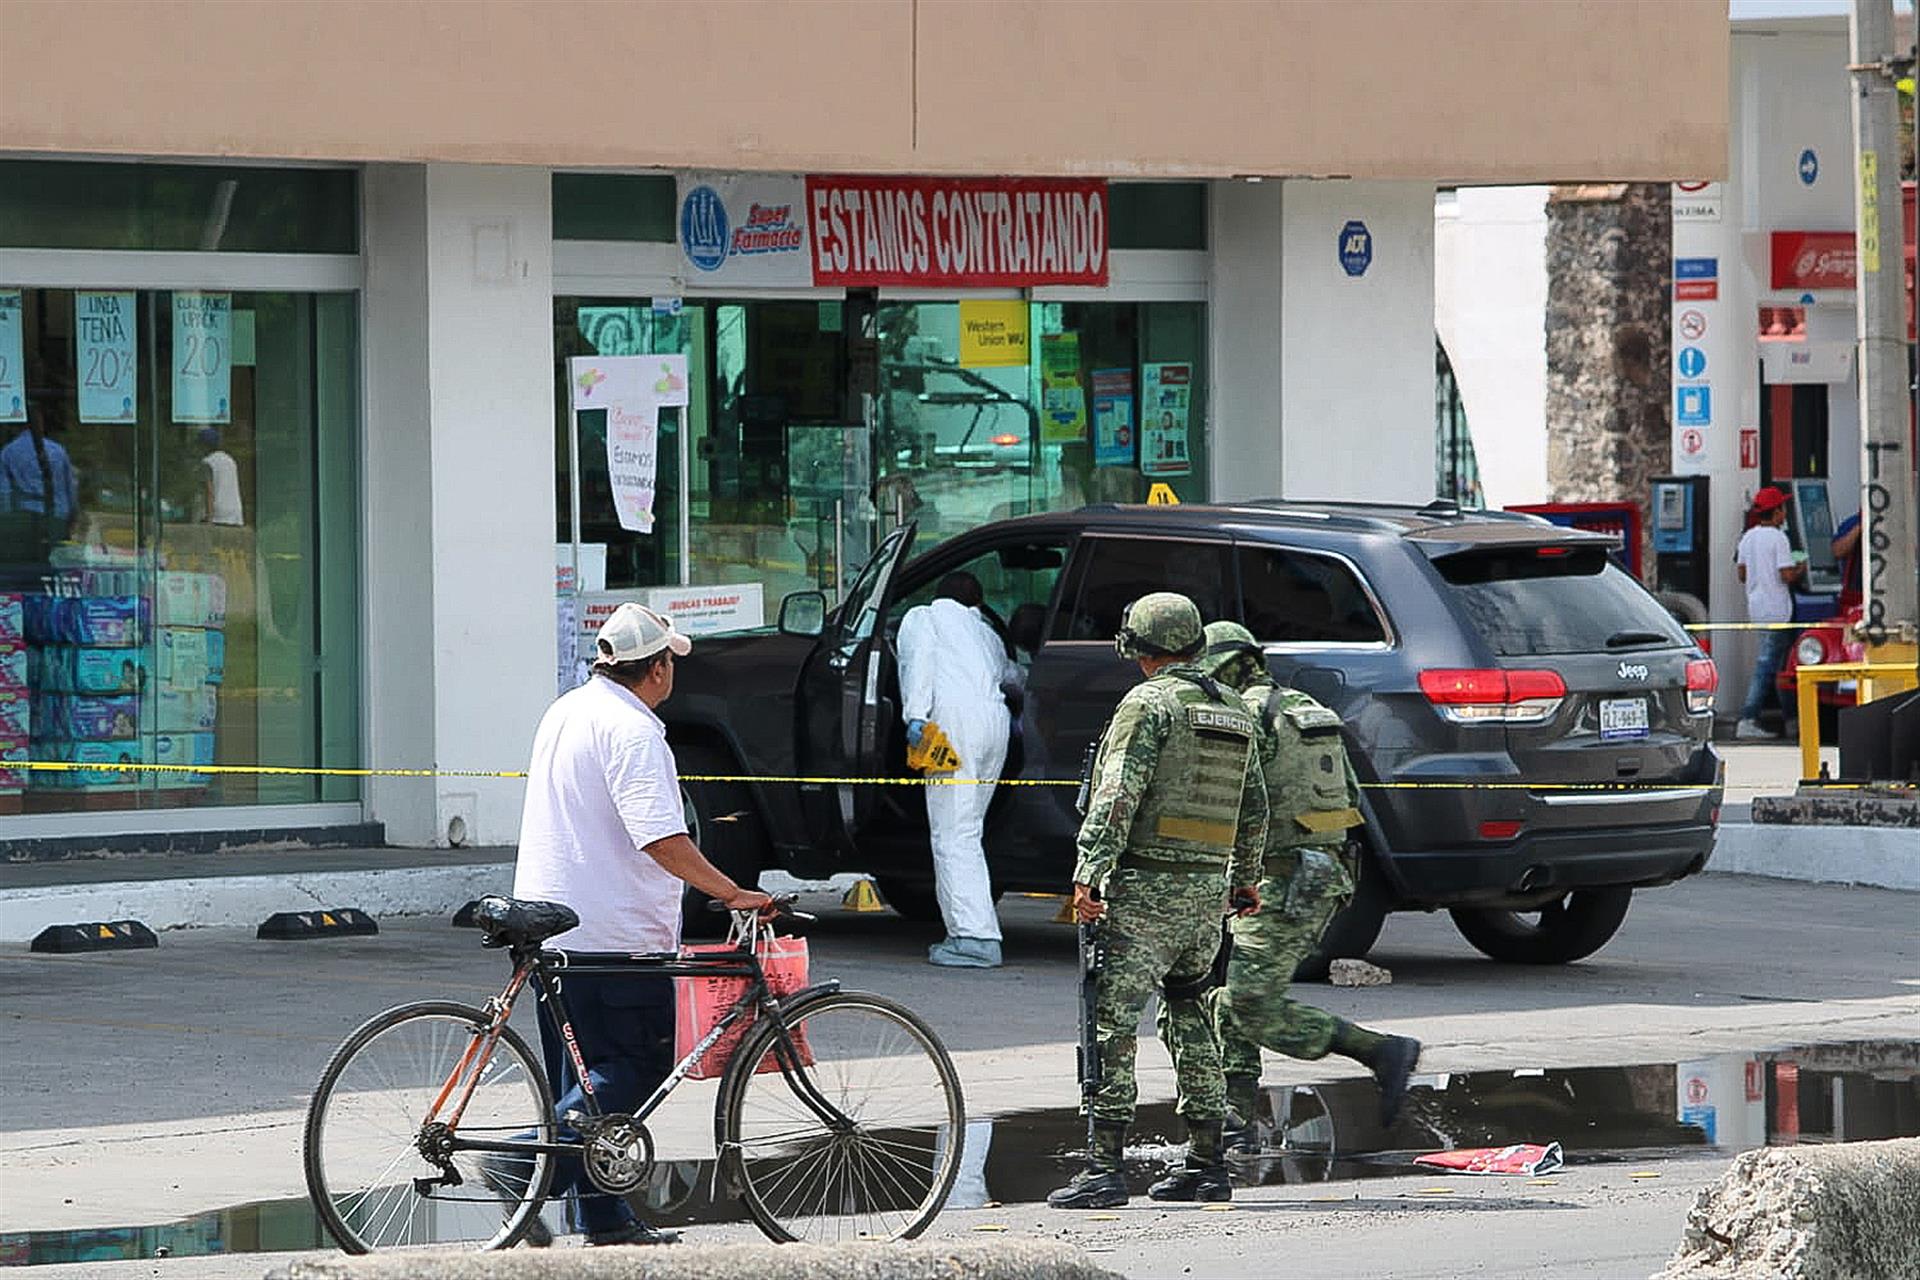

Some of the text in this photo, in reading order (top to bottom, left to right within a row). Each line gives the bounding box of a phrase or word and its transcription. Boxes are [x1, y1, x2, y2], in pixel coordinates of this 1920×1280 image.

[813, 188, 1104, 274] ESTAMOS CONTRATANDO
[79, 315, 127, 343] TENA
[966, 319, 1006, 332] Western
[978, 333, 1006, 347] Union
[1617, 661, 1649, 681] Jeep
